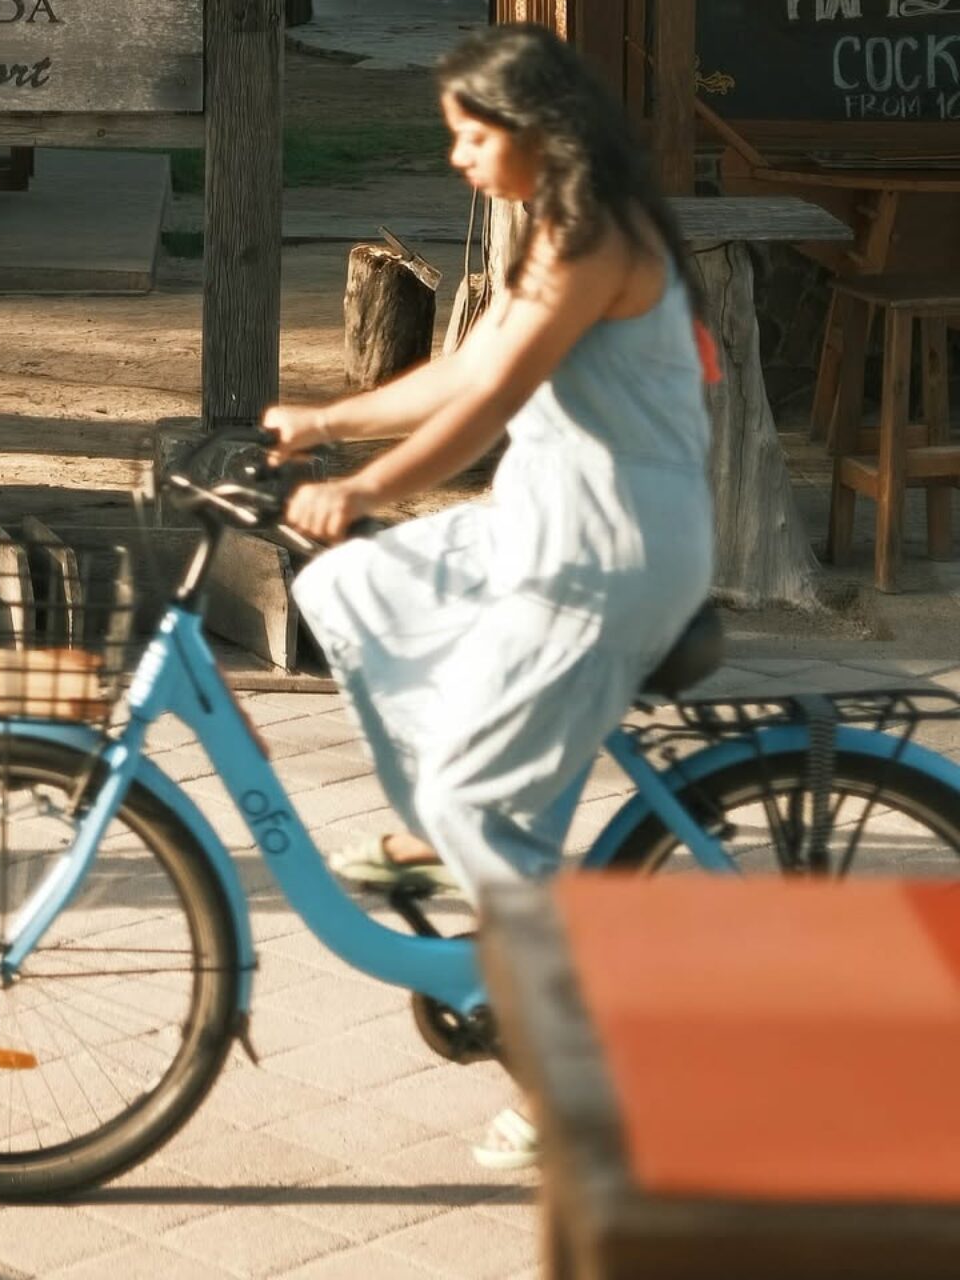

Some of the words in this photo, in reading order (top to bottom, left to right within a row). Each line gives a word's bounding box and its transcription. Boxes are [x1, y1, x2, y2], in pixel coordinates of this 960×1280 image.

[833, 34, 960, 92] COCK
[843, 93, 922, 119] FROM
[241, 789, 290, 854] ofo
